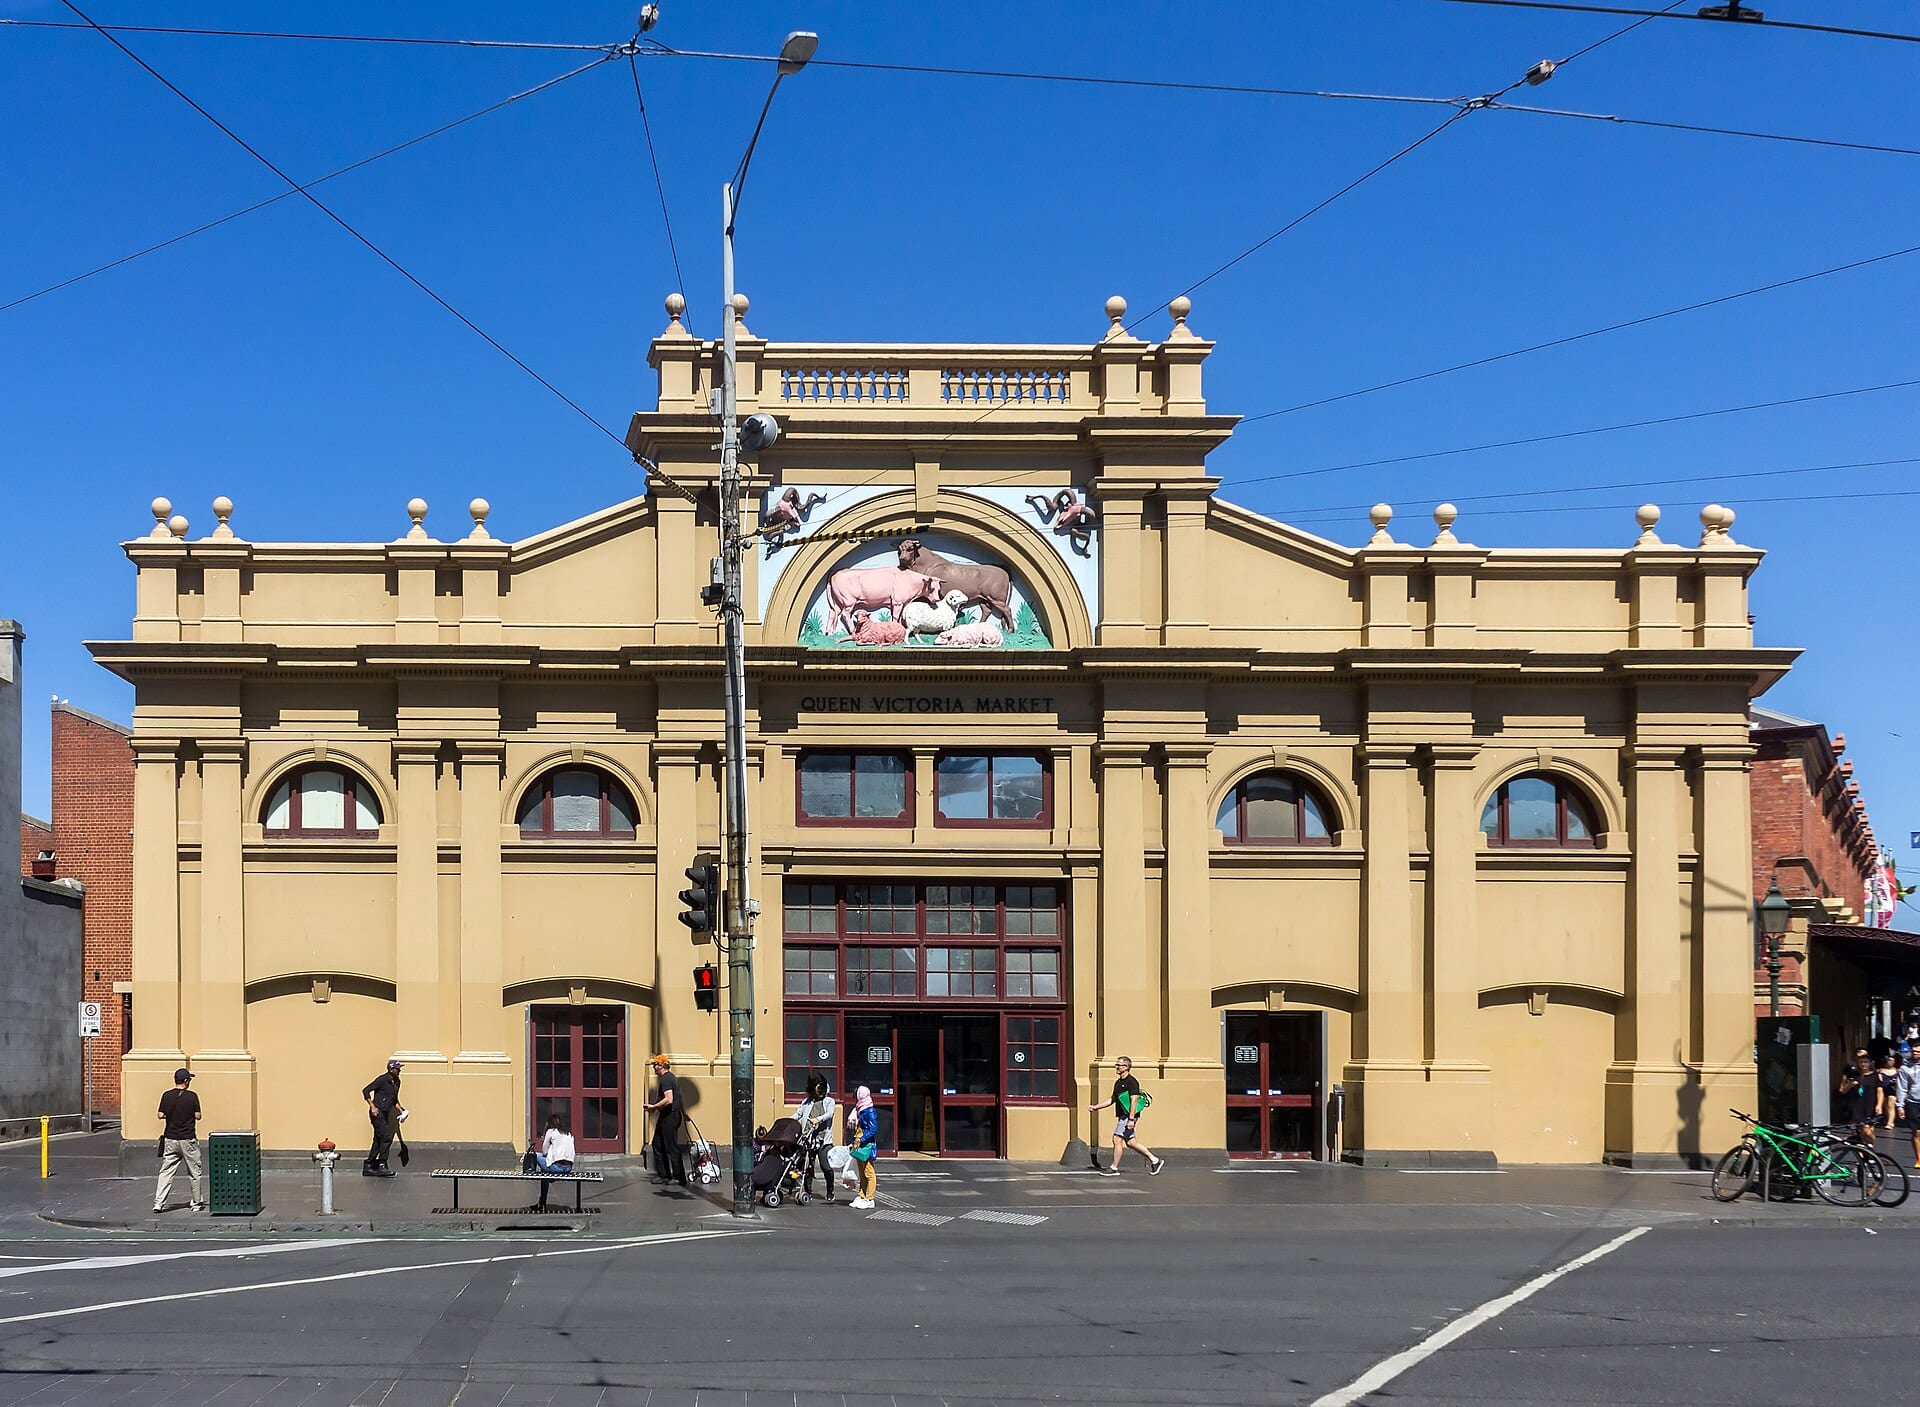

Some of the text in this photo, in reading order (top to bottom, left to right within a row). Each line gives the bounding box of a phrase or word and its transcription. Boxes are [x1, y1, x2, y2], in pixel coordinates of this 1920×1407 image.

[801, 696, 1054, 713] QUEEN VICTORIA MARKET
